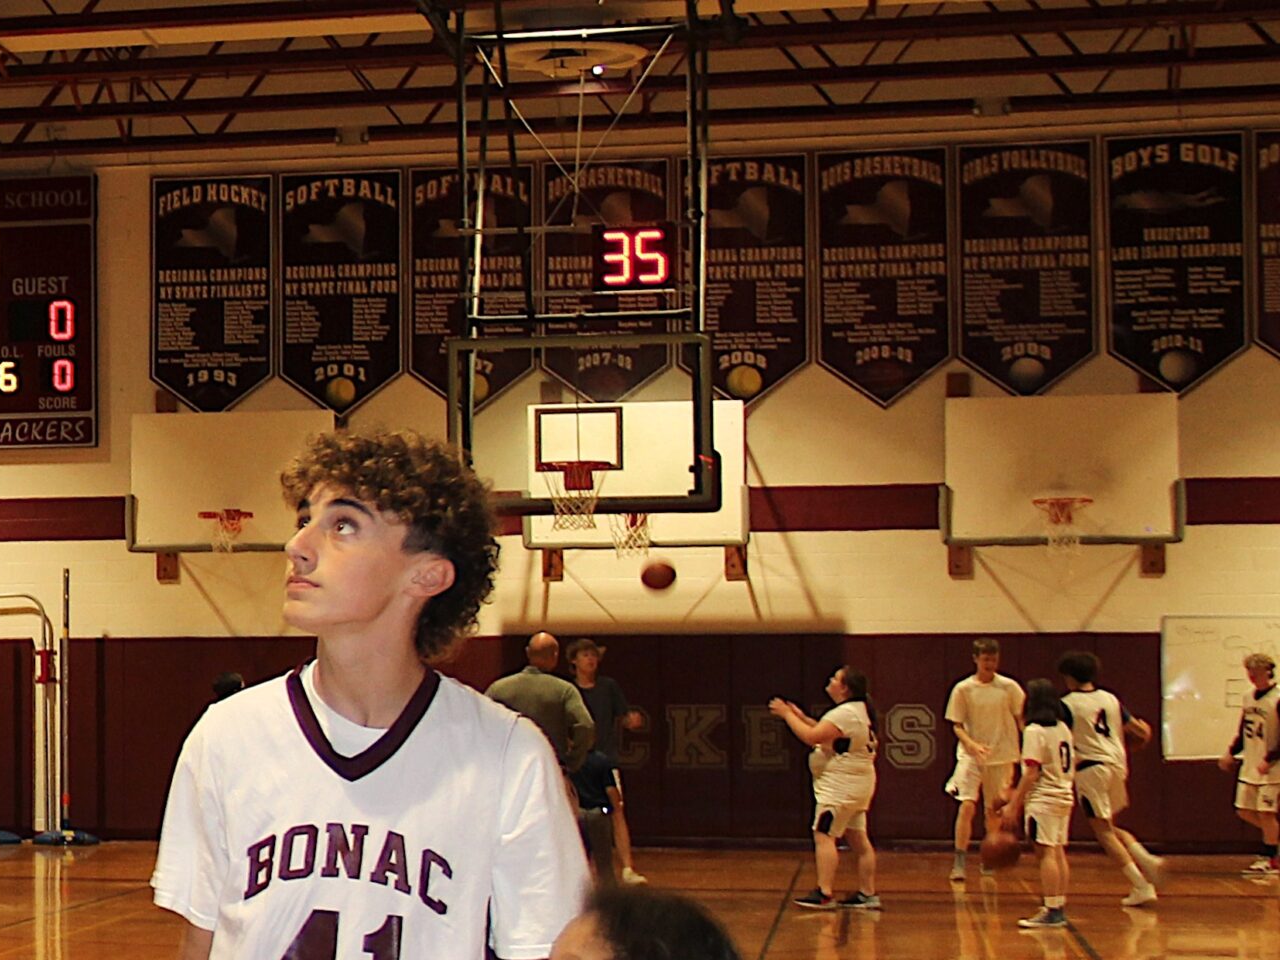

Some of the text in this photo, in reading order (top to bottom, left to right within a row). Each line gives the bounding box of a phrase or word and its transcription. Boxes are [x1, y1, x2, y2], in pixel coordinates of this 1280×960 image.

[963, 149, 1088, 184] GIRLS VOLLEYBALL
[1112, 141, 1239, 181] BOYS GOLF
[583, 166, 664, 199] BASKETBALL
[821, 155, 943, 192] BOYS BASKETBALL
[4, 189, 89, 210] SCHOOL
[159, 182, 267, 218] FIELD HOCKEY
[285, 177, 398, 213] SOFTBALL
[823, 244, 944, 262] REGIONAL CHAMPIONS
[964, 235, 1089, 254] REGIONAL CHAMPIONS
[1180, 242, 1243, 258] CHAMPIONS
[603, 228, 672, 287] 35
[980, 255, 1019, 270] STATE
[158, 266, 268, 284] REGIONAL CHAMPIONS
[285, 262, 397, 280] REGIONAL CHAMPIONS
[839, 263, 877, 279] STATE
[11, 276, 70, 297] GUEST
[159, 283, 267, 299] NY STATE FINALISTS
[285, 279, 398, 297] NY STATE FINAL FOUR
[47, 299, 77, 343] 0
[37, 343, 77, 358] FOULS
[51, 357, 76, 393] 0
[314, 363, 367, 382] 2001
[37, 395, 78, 411] SCORE
[1094, 708, 1110, 737] 4
[613, 703, 939, 770] CKES
[1059, 741, 1072, 775] 0
[242, 821, 454, 917] BONAC
